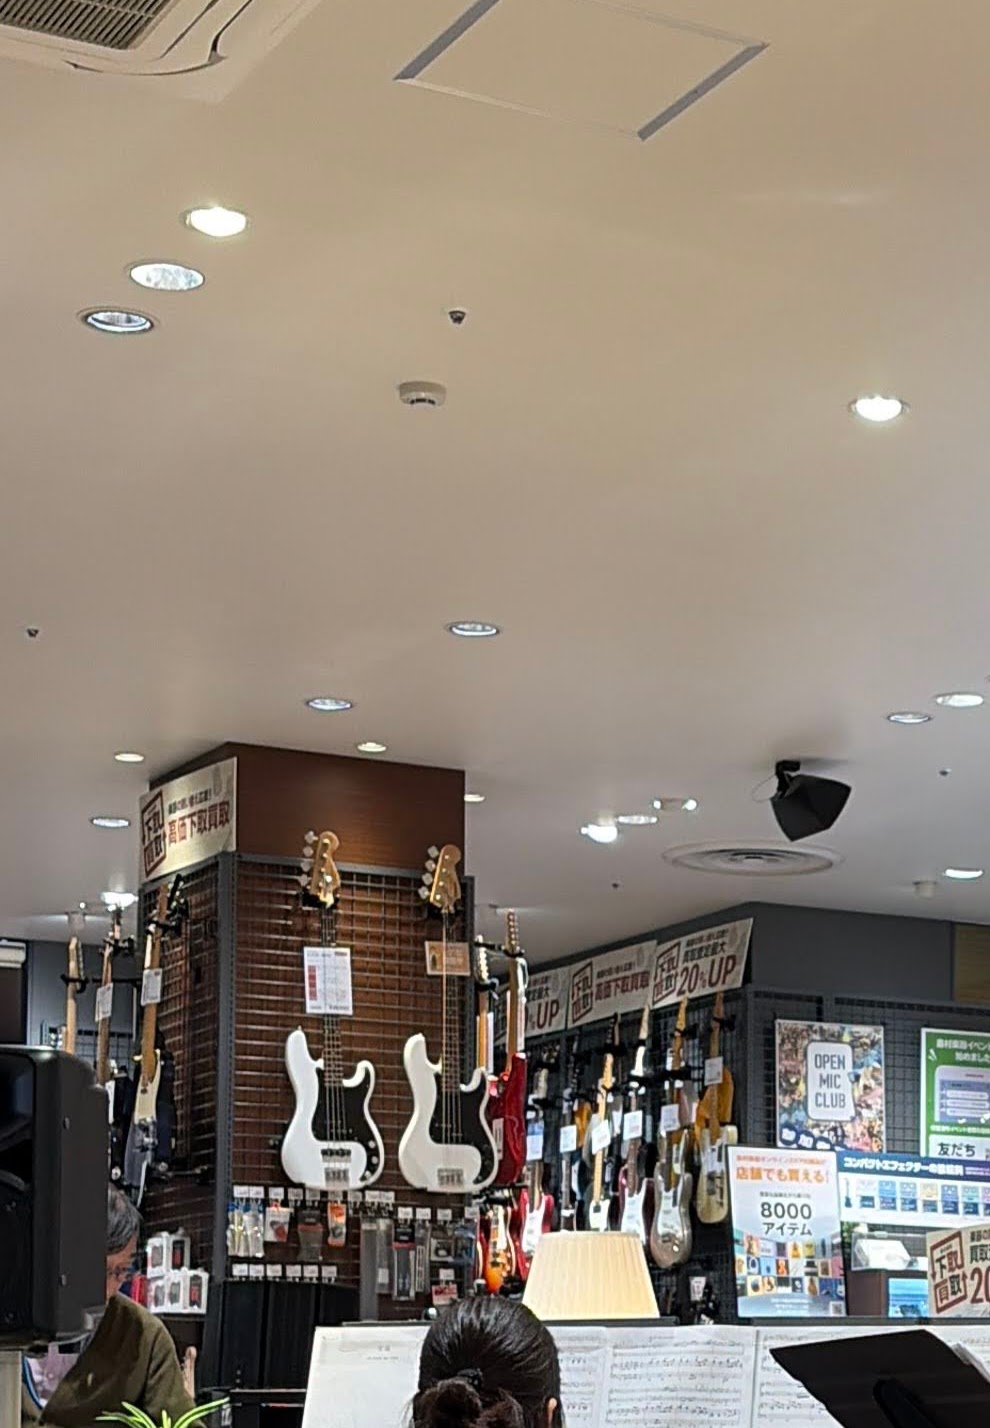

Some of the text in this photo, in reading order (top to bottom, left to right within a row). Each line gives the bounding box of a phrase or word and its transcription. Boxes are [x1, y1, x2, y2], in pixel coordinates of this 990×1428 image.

[815, 1054, 845, 1070] OPEN
[820, 1074, 841, 1089] MIC
[815, 1092, 846, 1108] CLUB
[938, 1142, 975, 1157] 友だち
[761, 1202, 812, 1220] 8000
[763, 1222, 812, 1236] アイテム
